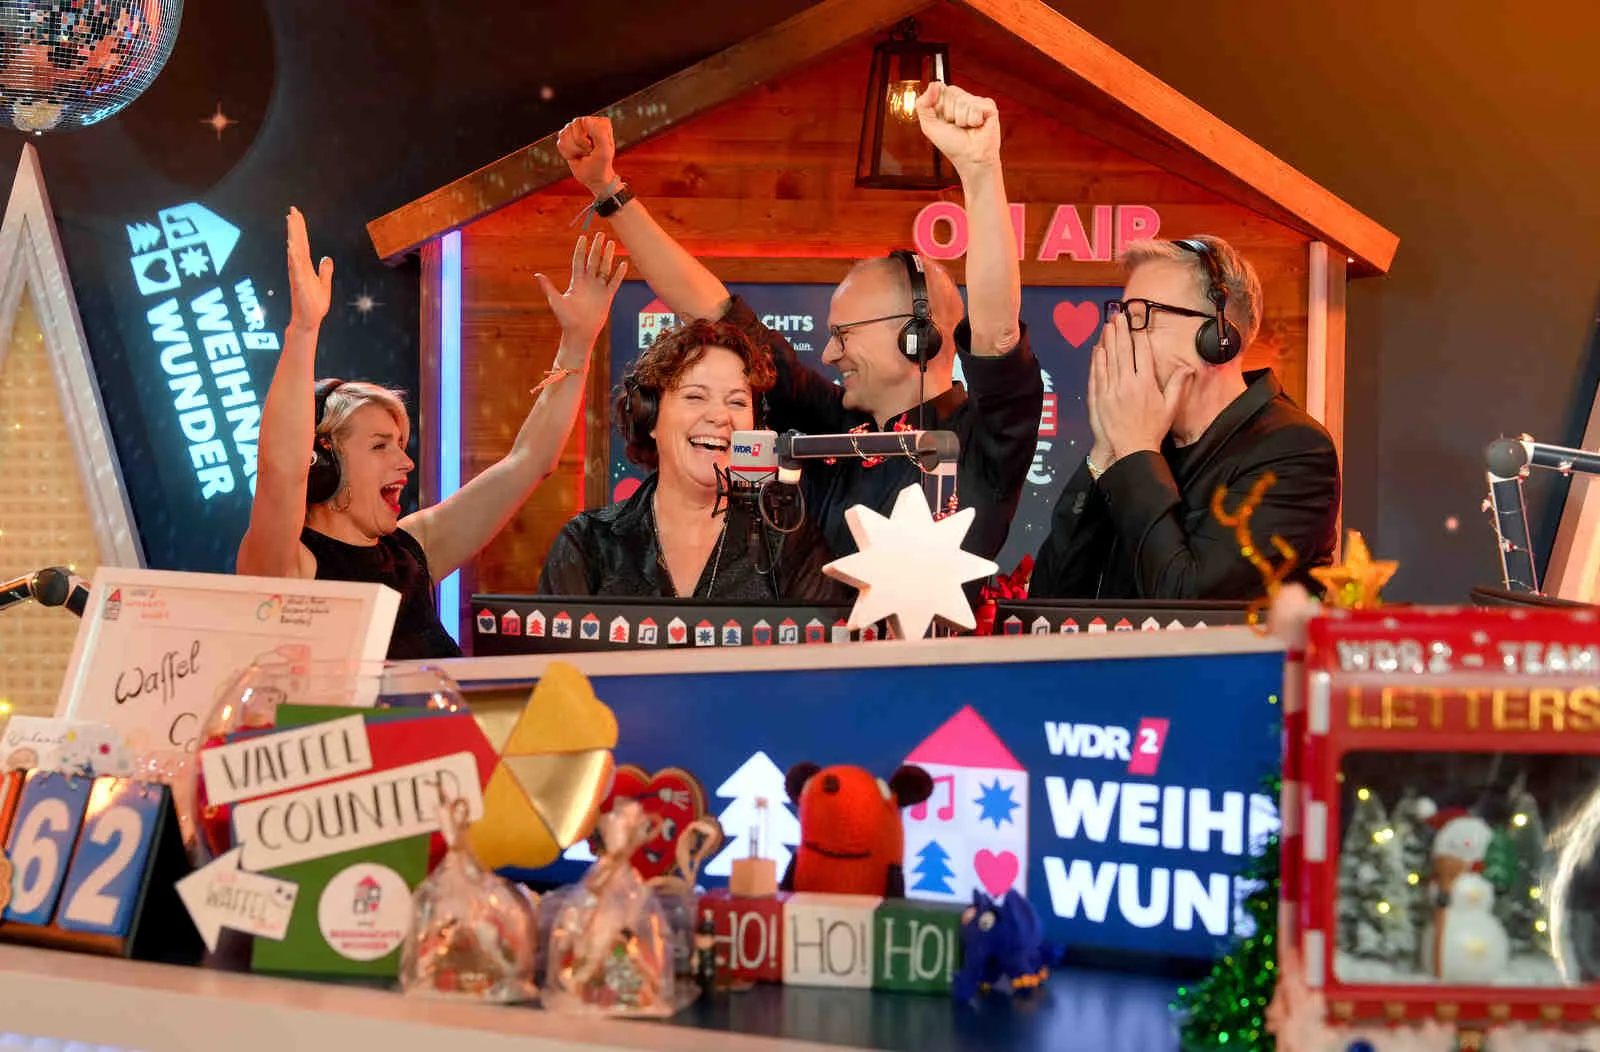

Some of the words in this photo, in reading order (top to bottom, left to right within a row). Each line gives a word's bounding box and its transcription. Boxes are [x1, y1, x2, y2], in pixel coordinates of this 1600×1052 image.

[1037, 204, 1161, 262] AIR
[234, 278, 265, 333] WDR
[146, 297, 236, 500] WUNDER
[190, 286, 263, 497] WEIHNA
[114, 640, 200, 705] Waffel
[1347, 685, 1600, 732] LETTERS
[1044, 721, 1133, 761] WDR
[790, 913, 869, 977] HO!
[883, 916, 955, 983] HO!
